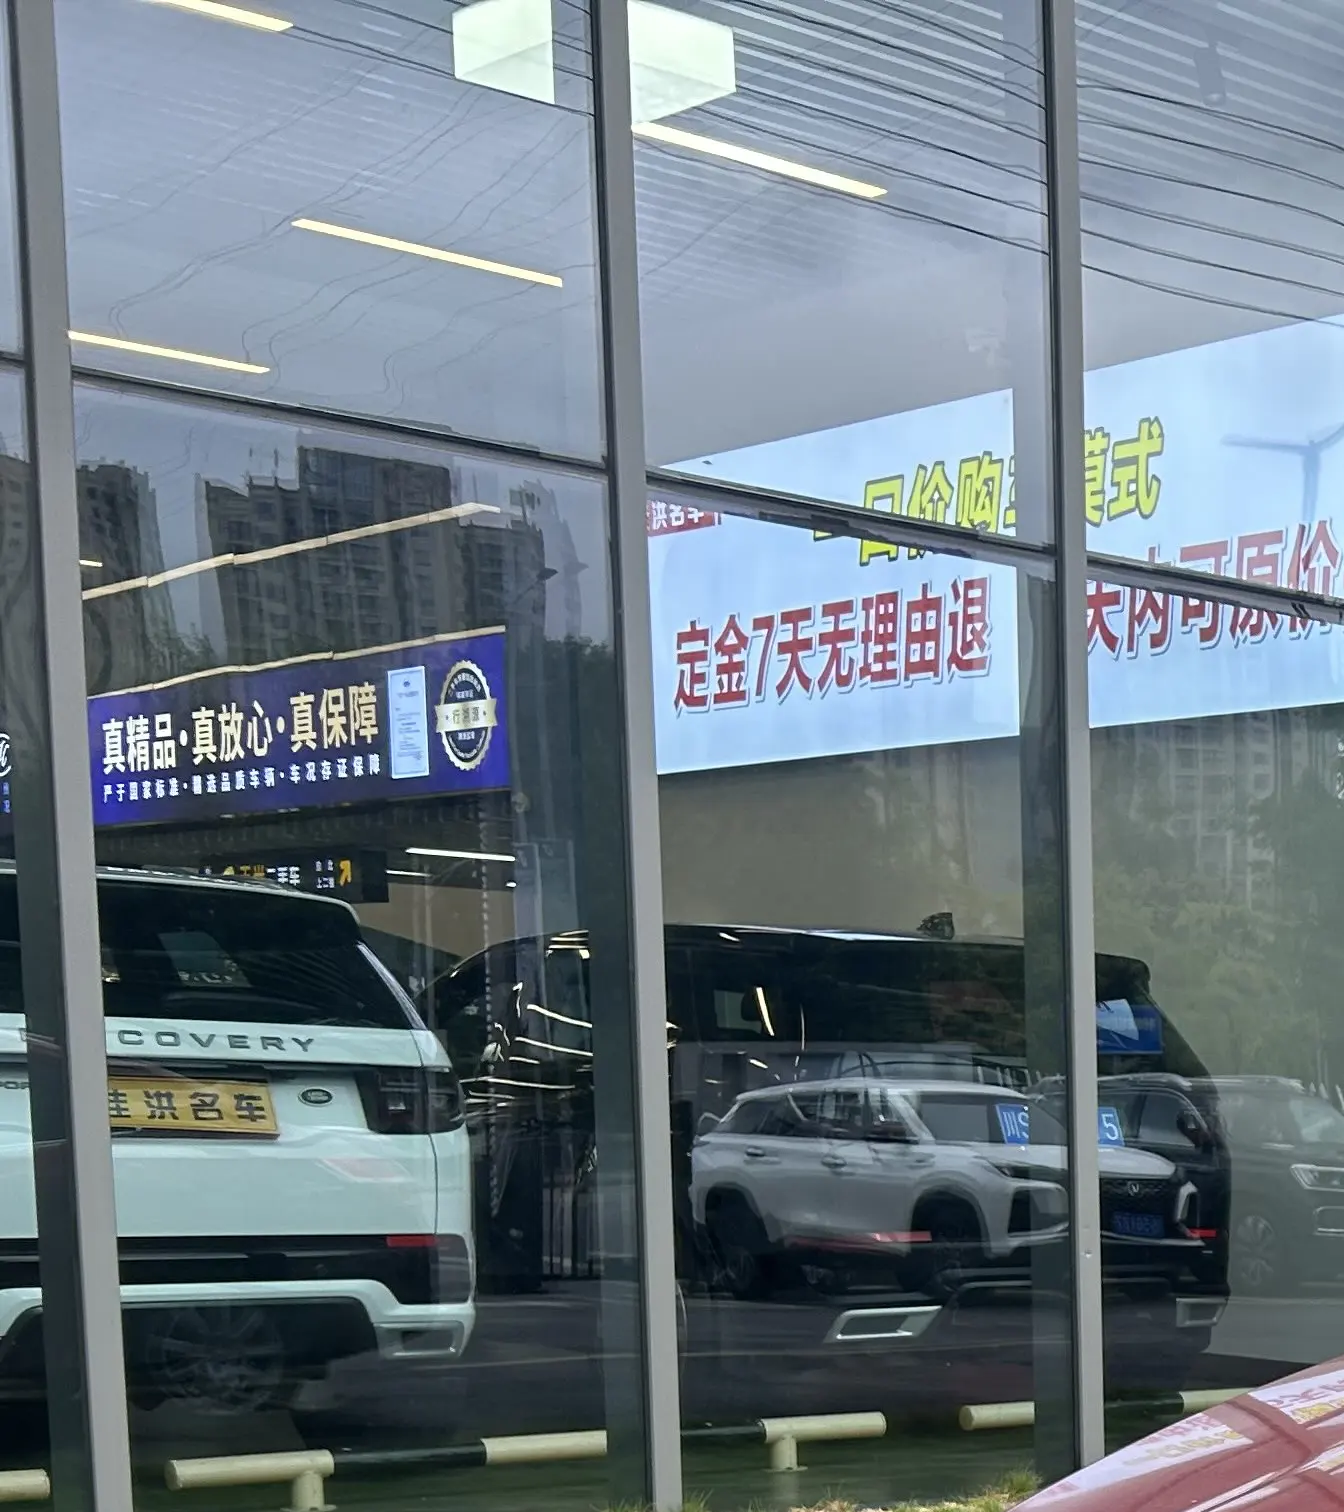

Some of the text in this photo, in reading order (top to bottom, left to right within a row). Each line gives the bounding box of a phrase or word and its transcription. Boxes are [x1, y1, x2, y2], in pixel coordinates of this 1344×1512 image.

[672, 576, 992, 718] 定金7天无理由退
[117, 1029, 314, 1052] COVERY
